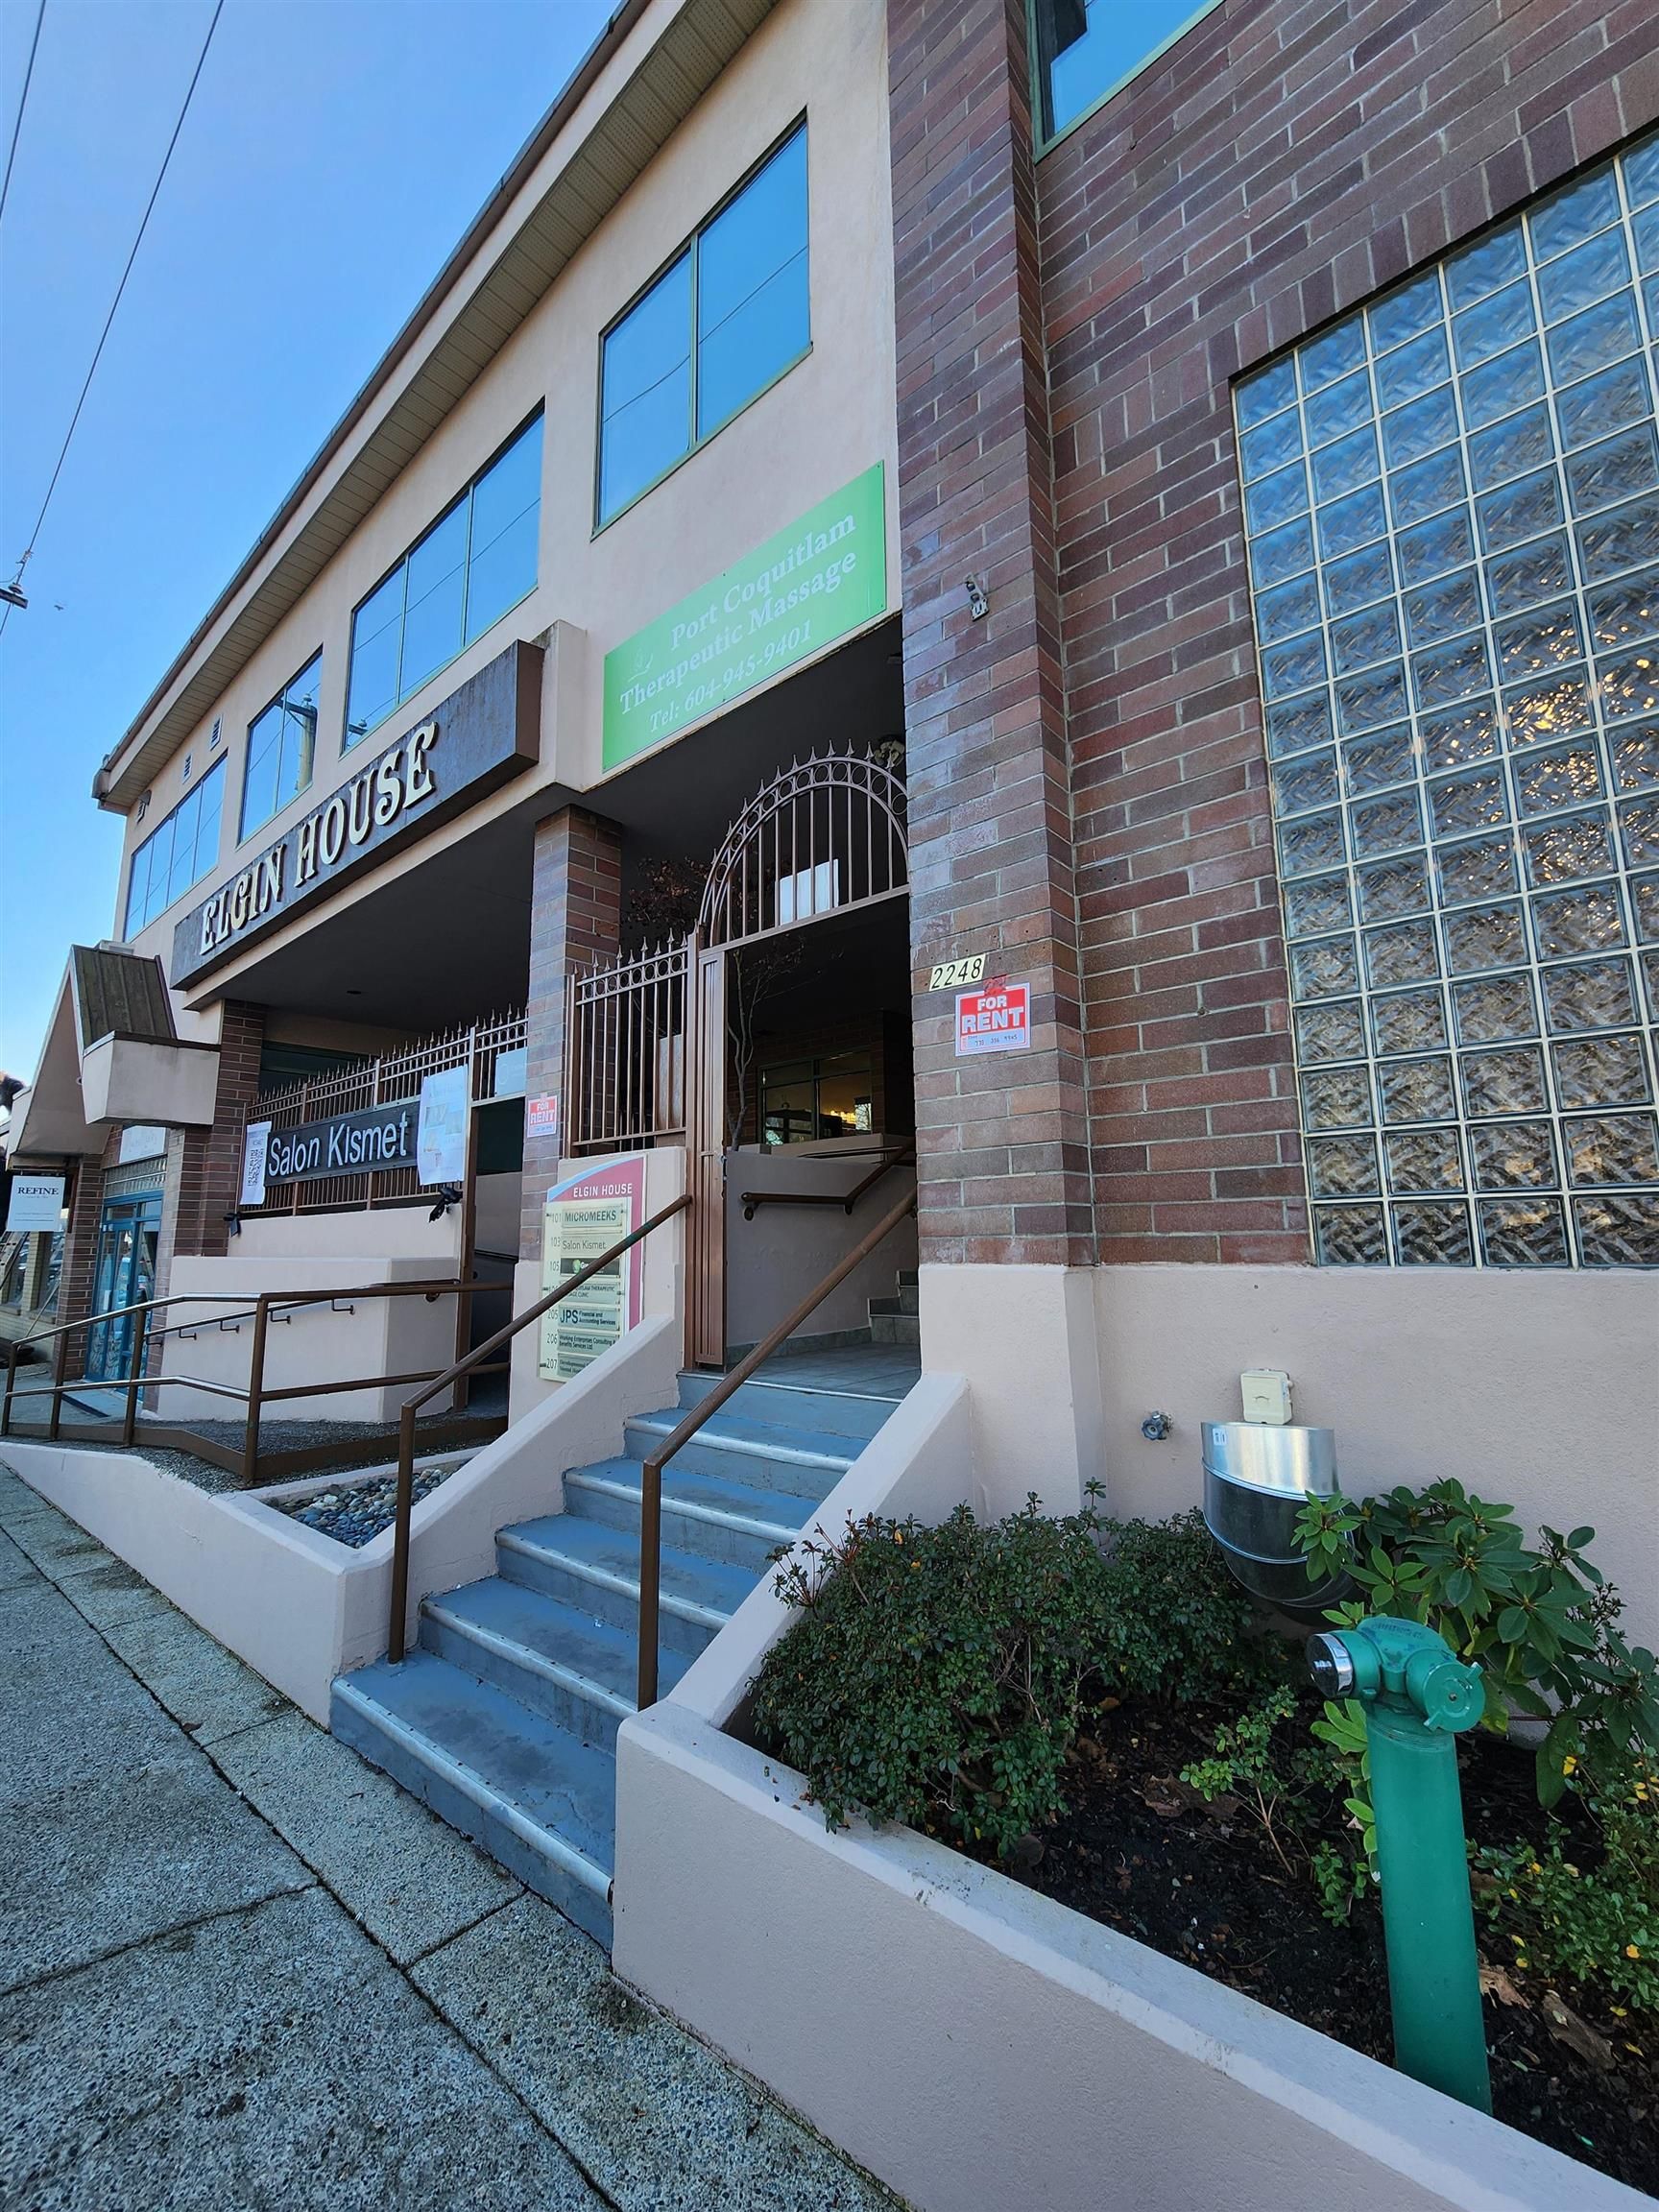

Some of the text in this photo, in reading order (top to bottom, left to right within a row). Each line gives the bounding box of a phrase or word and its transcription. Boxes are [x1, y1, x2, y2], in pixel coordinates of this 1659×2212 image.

[669, 514, 856, 650] Port Coquitlam
[619, 552, 856, 714] Therapeutic Massage
[649, 620, 812, 733] Tel: 604-945-9401
[200, 721, 439, 955] ELGIN HOUSE
[931, 957, 983, 989] 2248
[976, 994, 1008, 1012] FOR
[961, 1006, 1024, 1034] RENT
[537, 1101, 550, 1112] FOR
[530, 1110, 555, 1124] RENT
[268, 1134, 320, 1177] Salon
[17, 1187, 60, 1195] REFINE
[573, 1183, 633, 1197] ELGIN HOUSE
[551, 1210, 616, 1223] 101 MICROMEEKS
[563, 1239, 580, 1250] Salon
[582, 1238, 607, 1250] Kismet
[549, 1260, 560, 1272] 105
[560, 1309, 579, 1324] JPS
[546, 1333, 558, 1345] 206
[546, 1358, 557, 1369] 207
